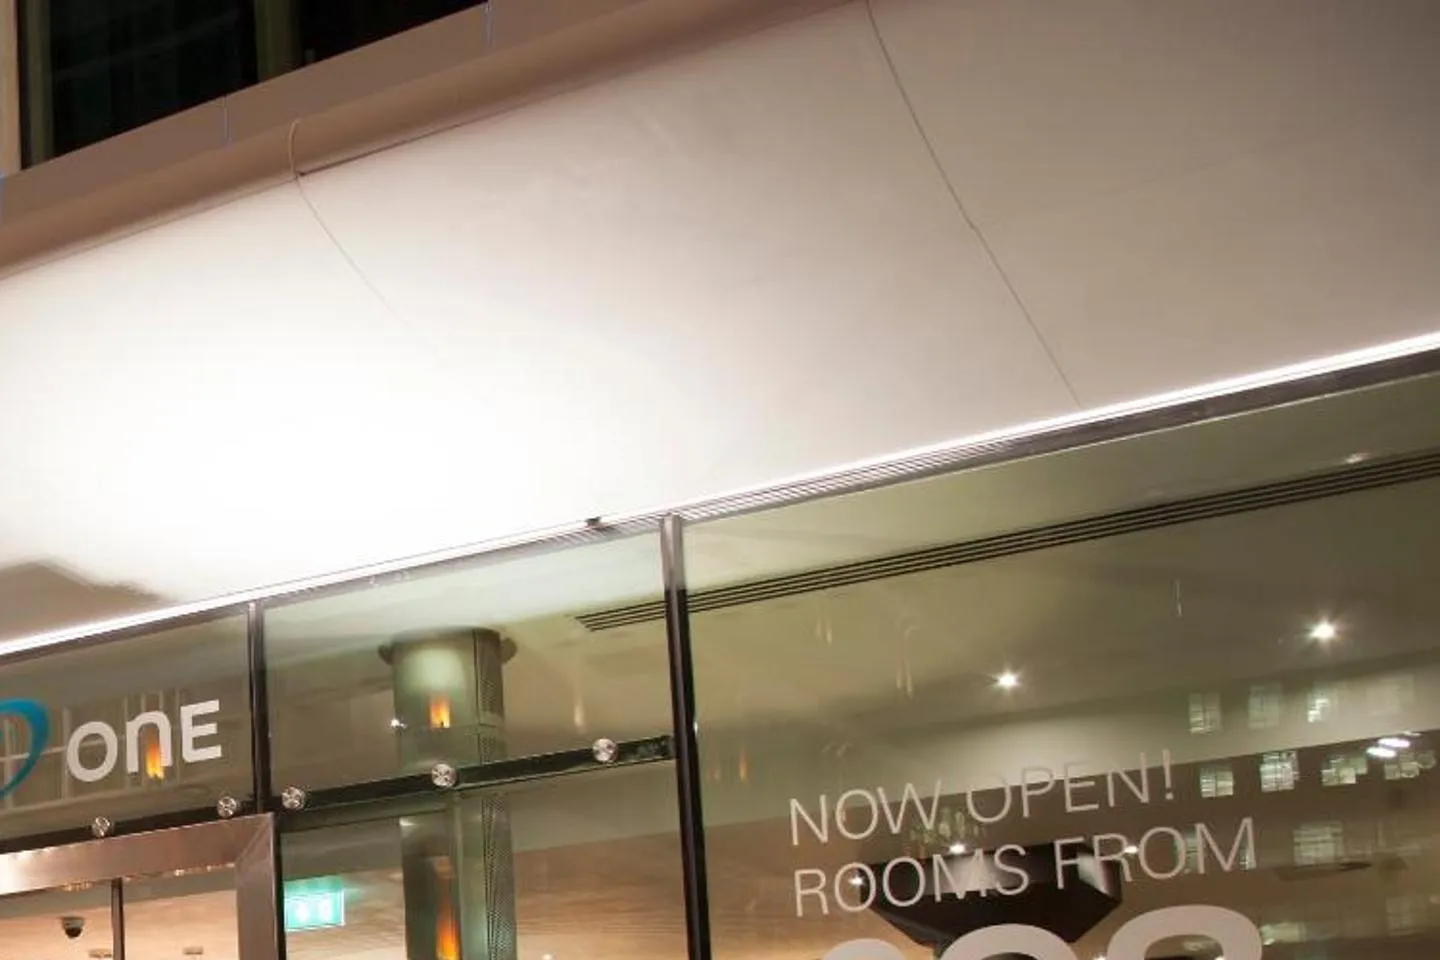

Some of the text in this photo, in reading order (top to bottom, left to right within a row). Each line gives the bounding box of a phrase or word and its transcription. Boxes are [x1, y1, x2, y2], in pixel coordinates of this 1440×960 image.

[790, 748, 1175, 846] NOW OPEN!
[794, 817, 1259, 918] ROOMS FROM
